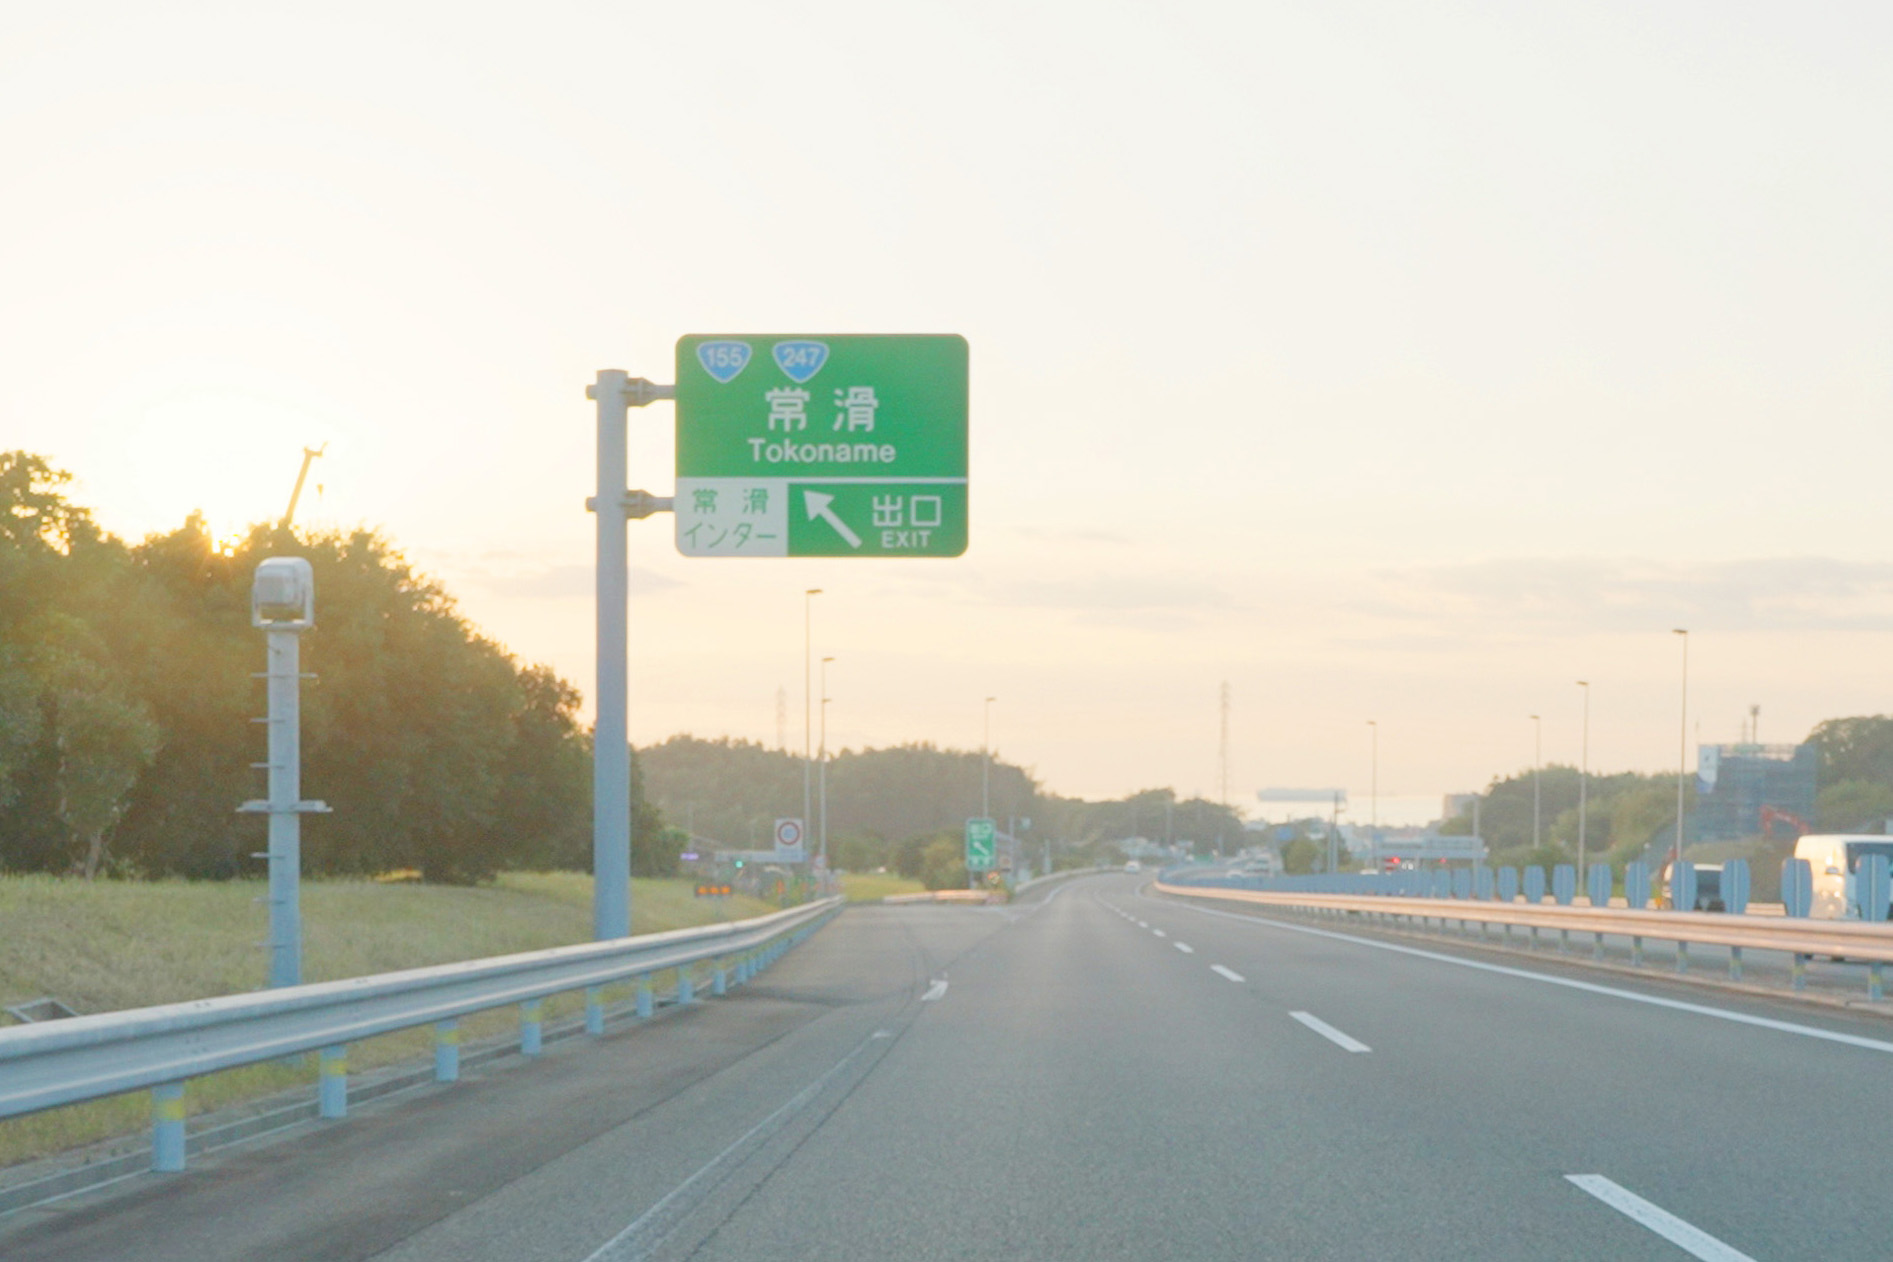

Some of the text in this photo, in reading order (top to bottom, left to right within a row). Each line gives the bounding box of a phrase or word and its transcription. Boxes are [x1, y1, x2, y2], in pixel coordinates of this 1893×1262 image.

[706, 348, 743, 367] 155
[783, 347, 819, 367] 247
[765, 386, 879, 432] 常滑
[747, 438, 896, 463] Tokoname
[692, 488, 769, 515] 常滑
[872, 495, 941, 527] 出口
[683, 522, 776, 549] インター
[881, 530, 932, 548] EXIT
